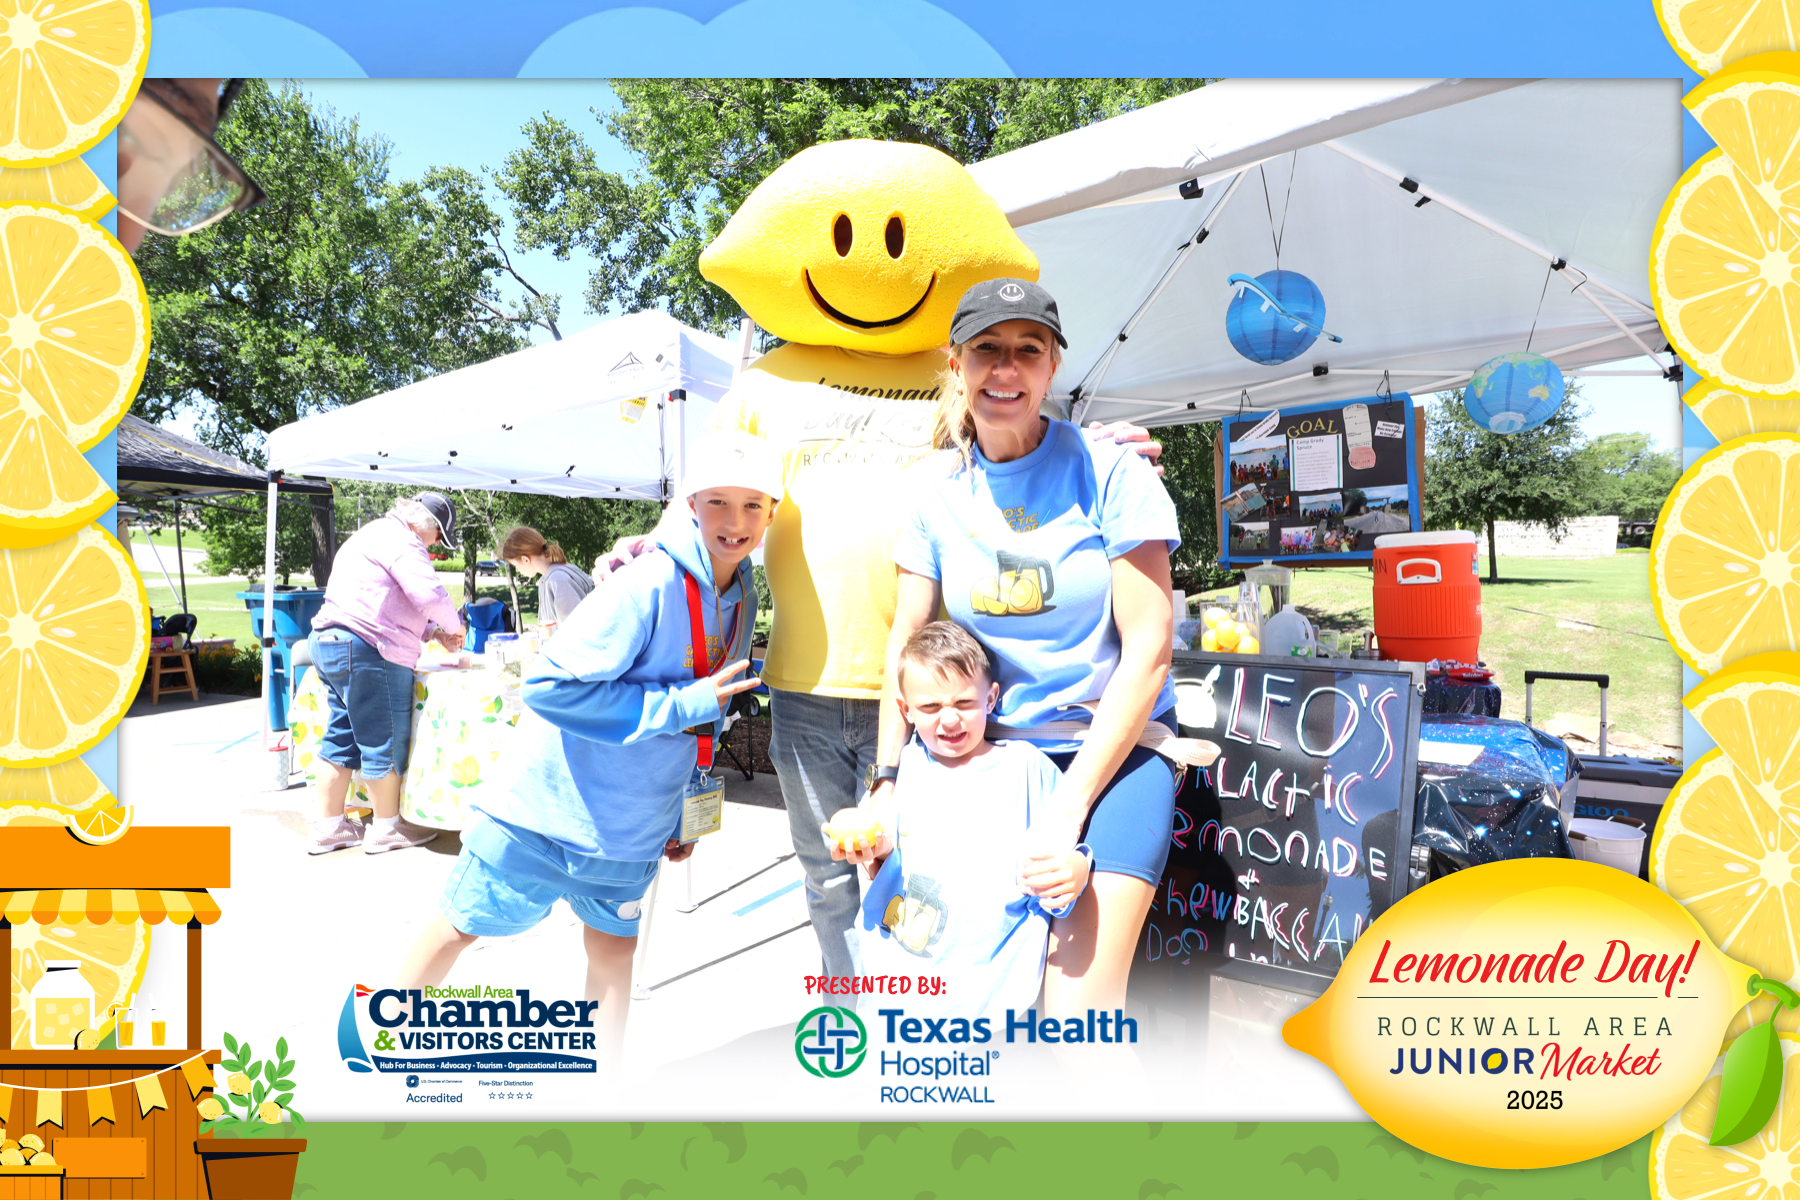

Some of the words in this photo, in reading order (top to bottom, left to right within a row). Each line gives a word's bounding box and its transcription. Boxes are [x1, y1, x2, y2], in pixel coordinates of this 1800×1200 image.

[804, 408, 876, 438] ay!
[1287, 418, 1339, 439] GOAL
[1002, 506, 1025, 518] O'S
[1008, 512, 1039, 528] CTIC
[705, 635, 719, 646] EO'S
[1225, 668, 1398, 779] LEO'S
[1574, 804, 1630, 817] GLOO
